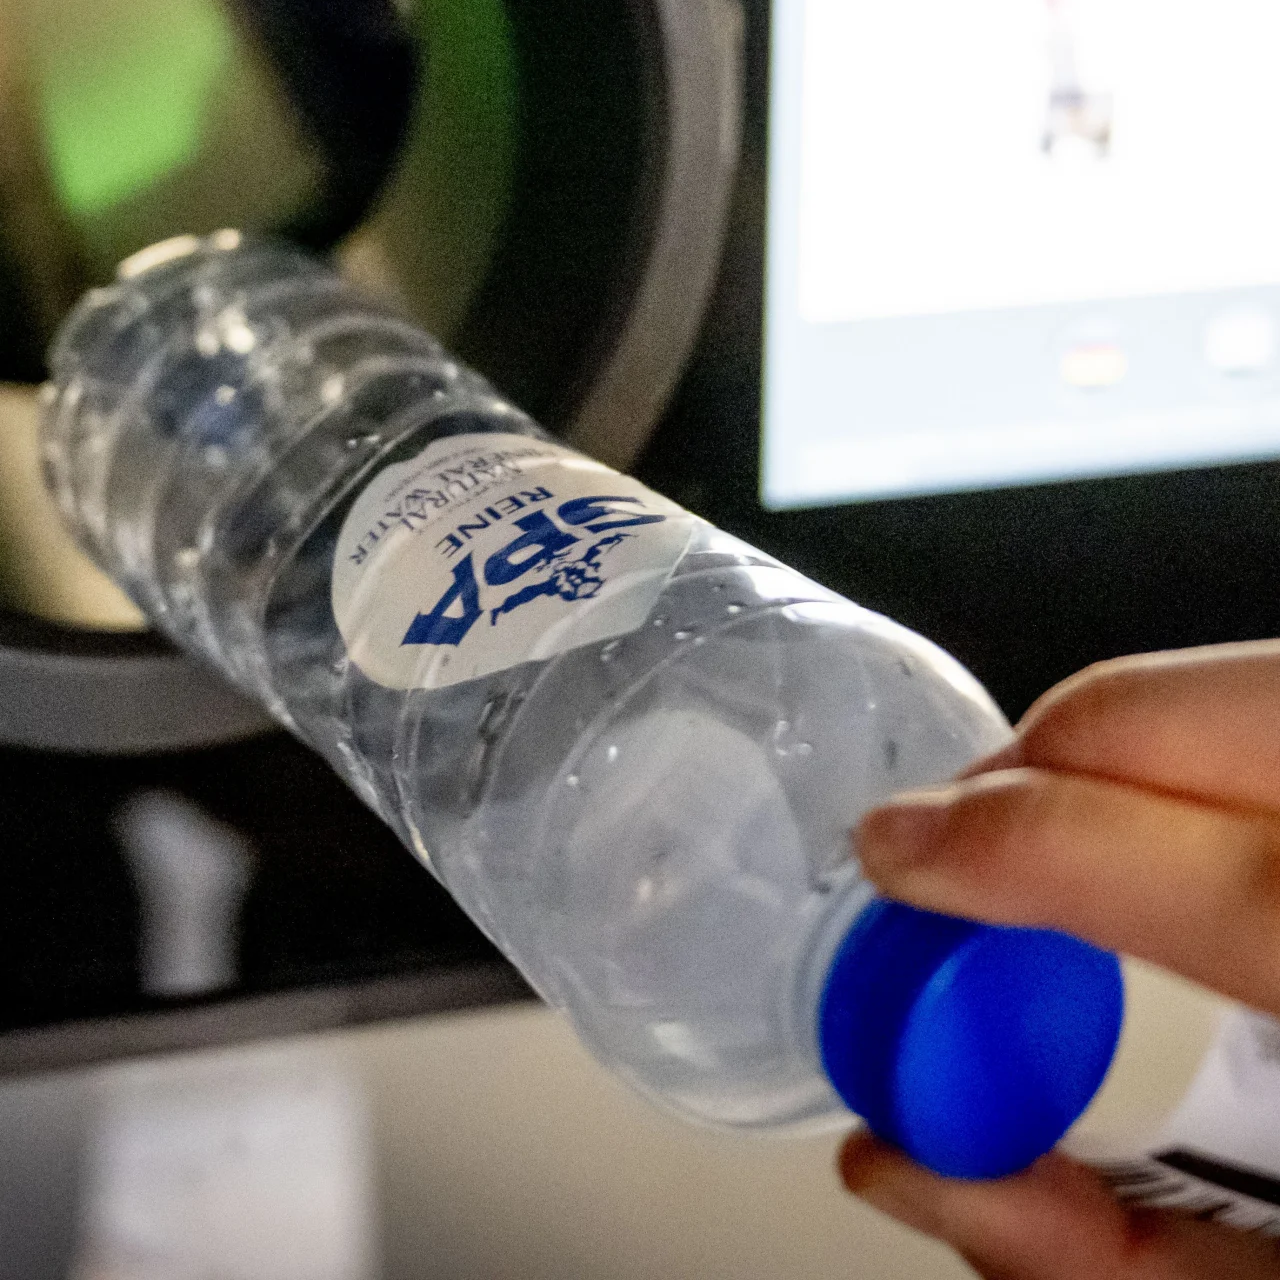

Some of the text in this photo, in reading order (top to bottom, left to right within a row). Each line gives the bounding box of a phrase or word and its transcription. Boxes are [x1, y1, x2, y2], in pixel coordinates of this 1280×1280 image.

[349, 488, 428, 565] WATER
[434, 486, 554, 559] REINE
[399, 495, 667, 647] SPA
